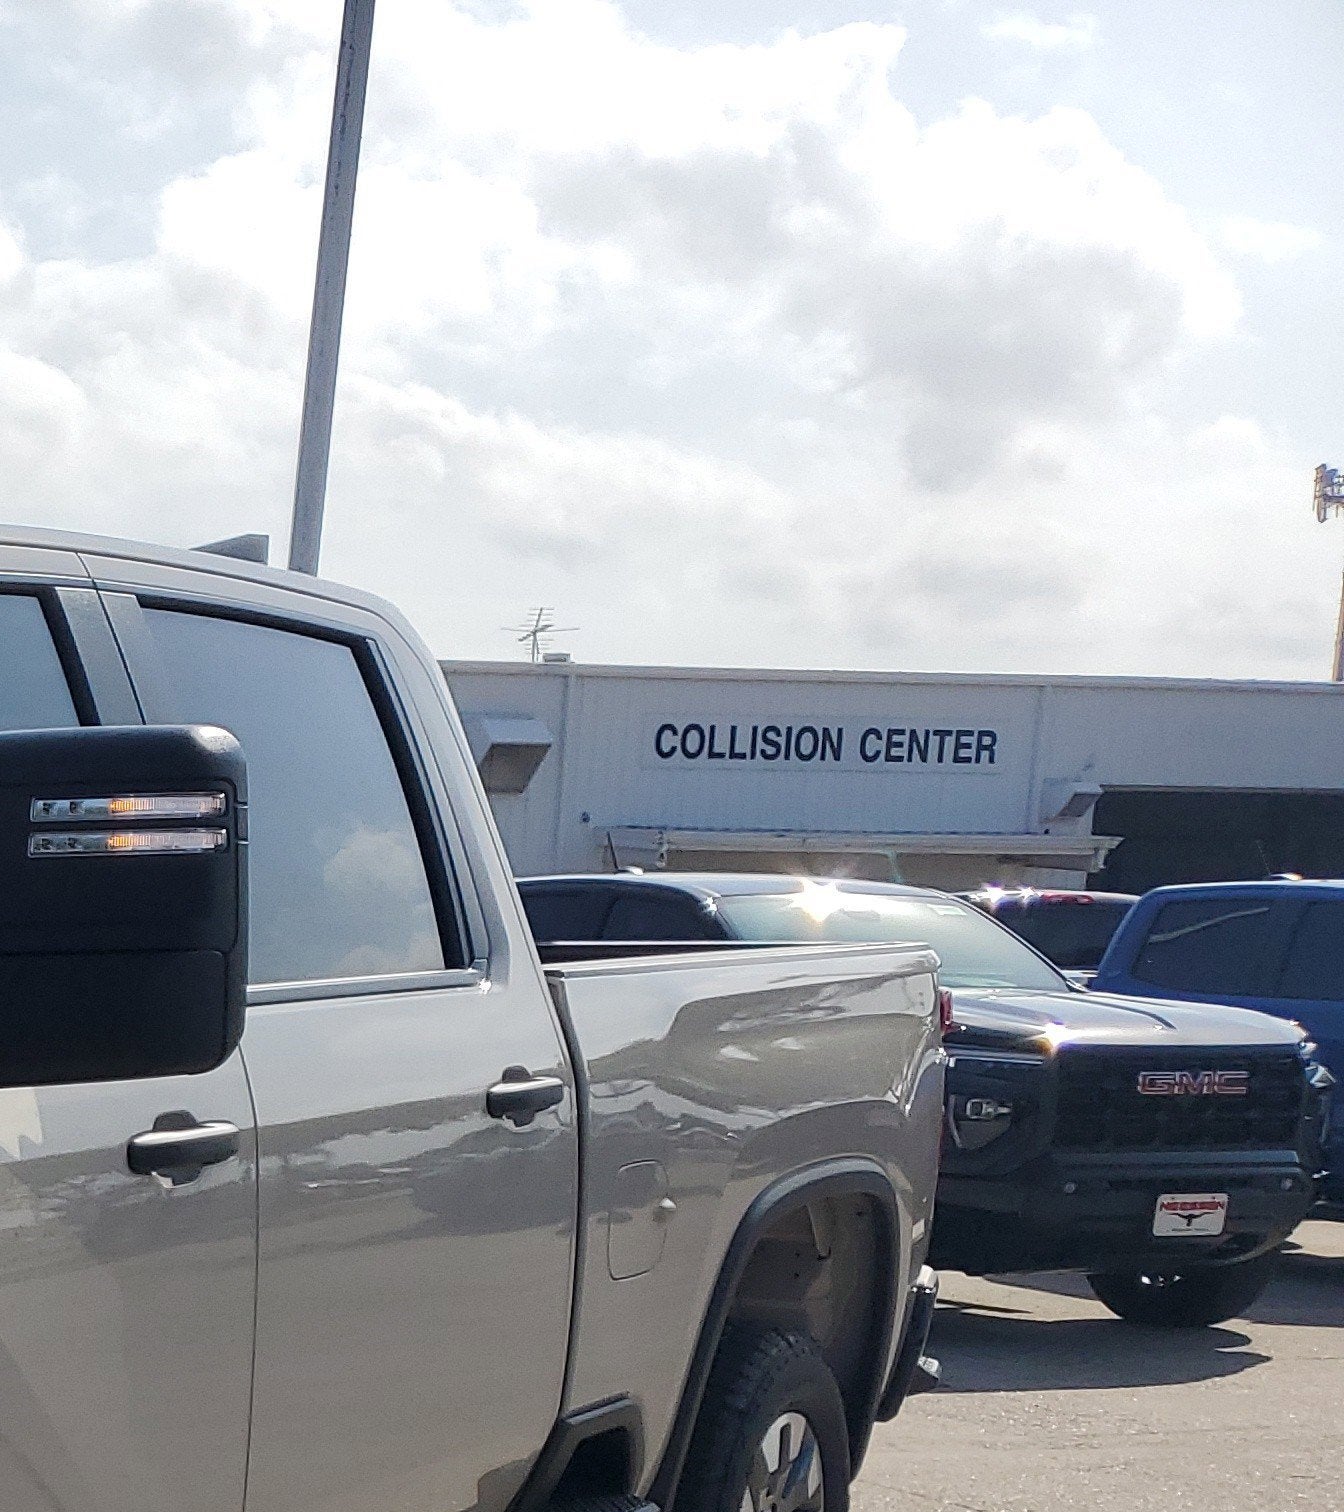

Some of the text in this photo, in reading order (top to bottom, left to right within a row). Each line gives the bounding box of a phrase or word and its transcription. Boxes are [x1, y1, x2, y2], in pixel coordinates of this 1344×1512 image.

[655, 723, 999, 765] COLLISION CENTER
[1137, 1071, 1249, 1095] GMC
